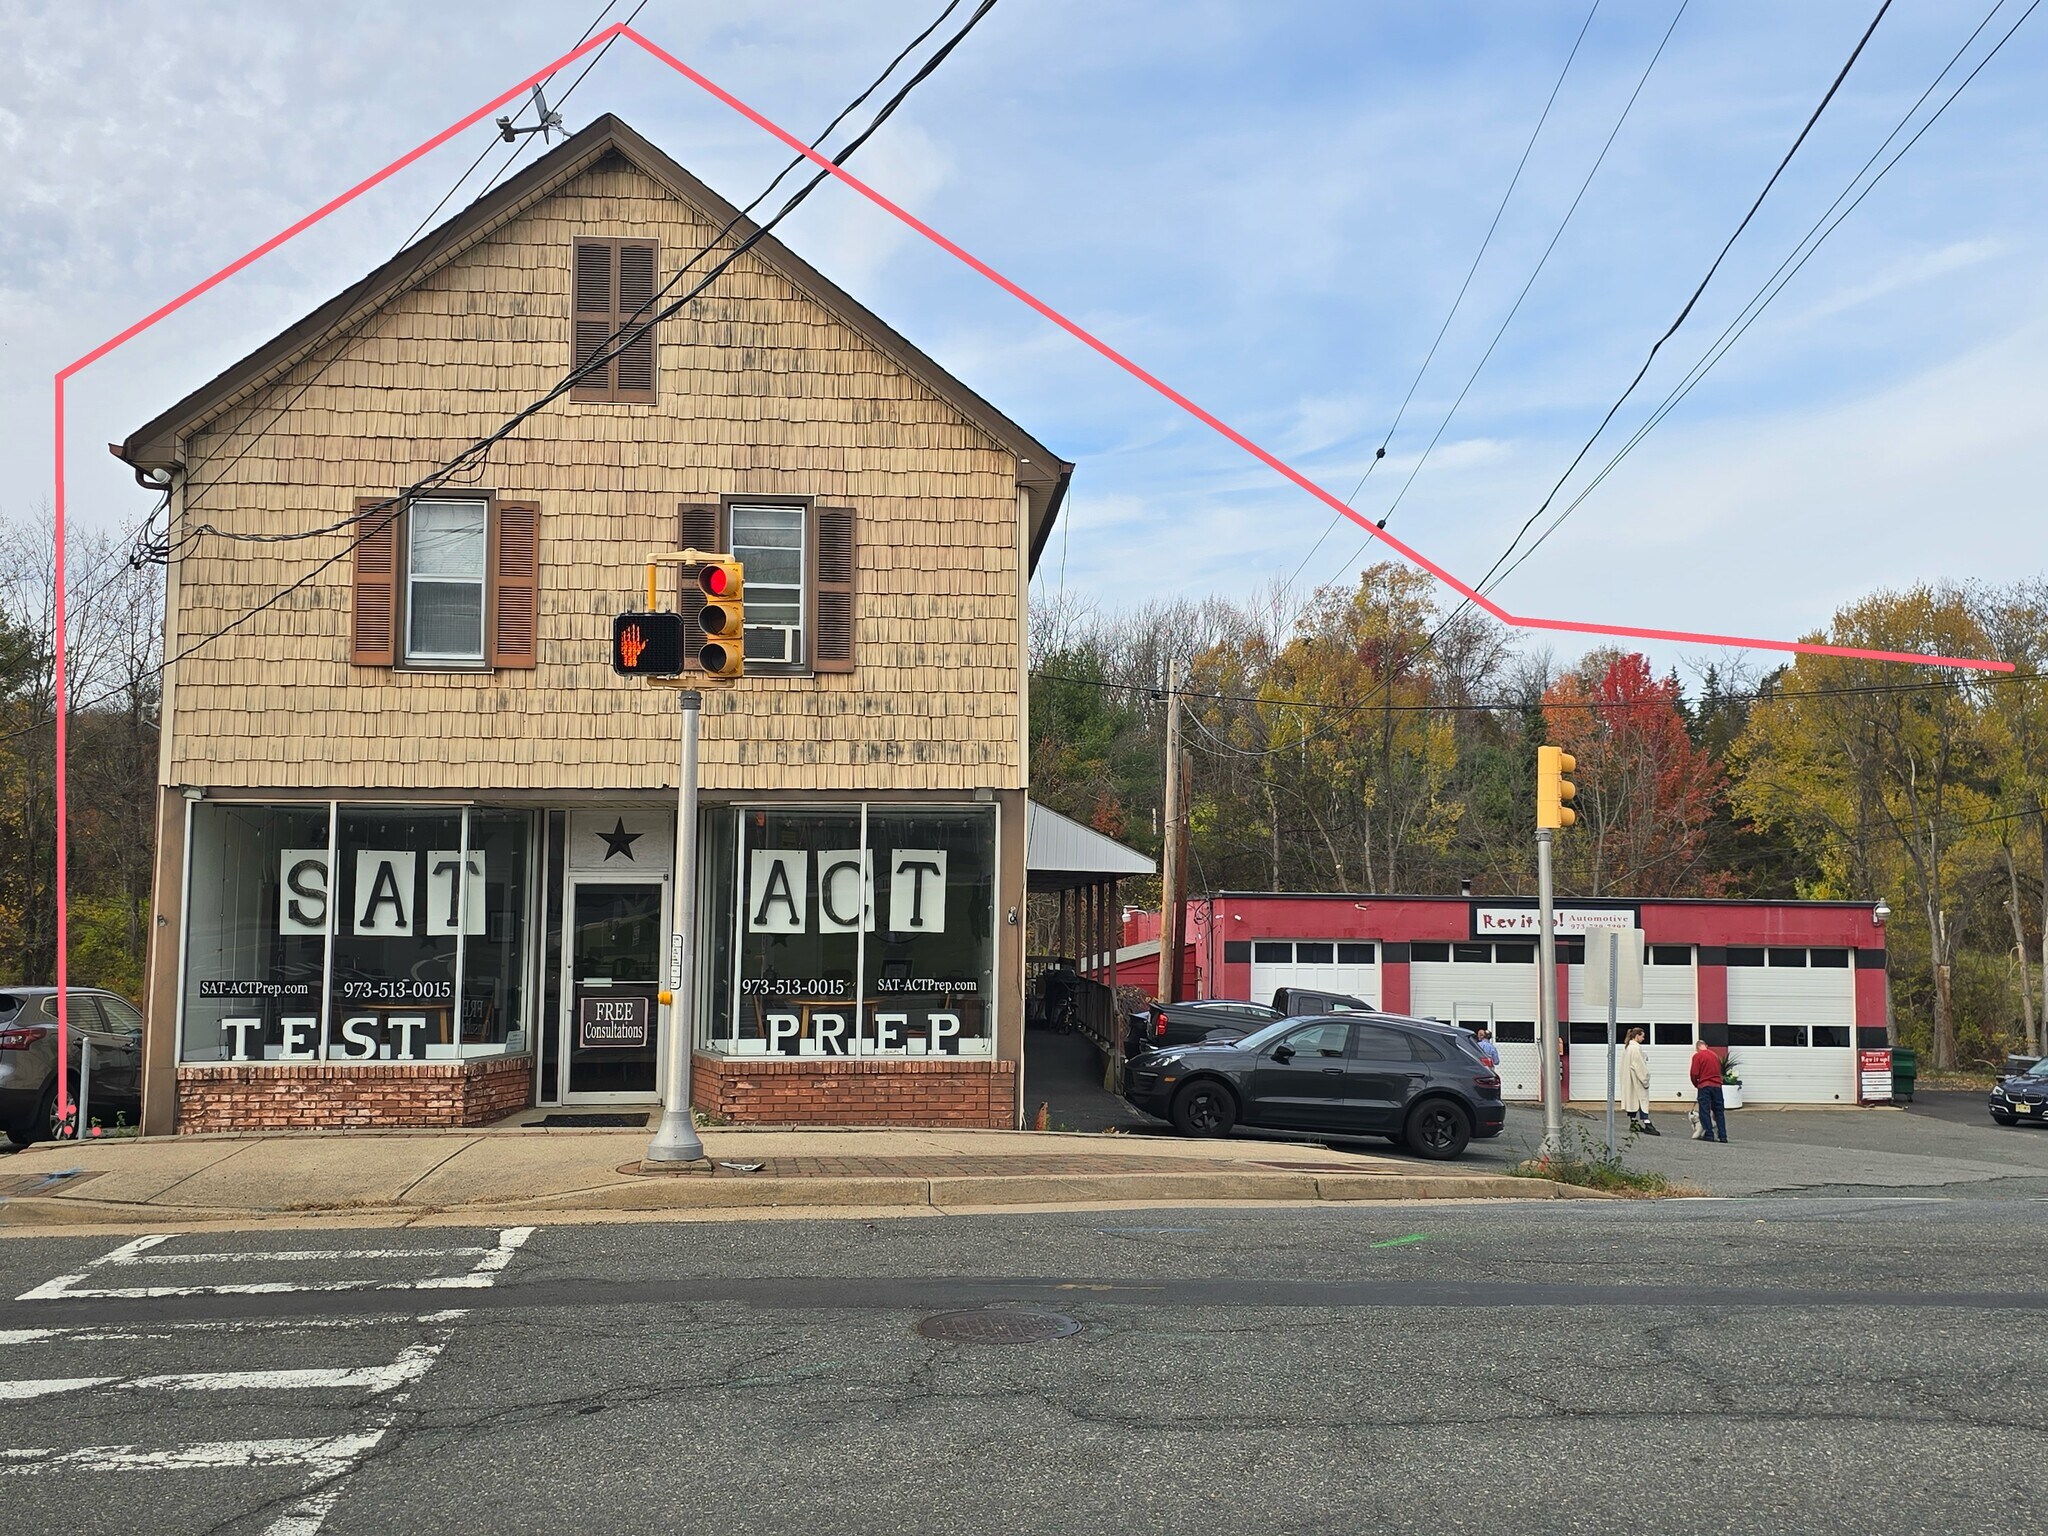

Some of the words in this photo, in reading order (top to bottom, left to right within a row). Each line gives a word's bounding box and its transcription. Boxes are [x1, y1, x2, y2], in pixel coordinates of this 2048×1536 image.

[287, 859, 480, 928] SAT
[754, 859, 941, 926] ACT
[1483, 913, 1516, 928] Rev
[1520, 914, 1533, 928] it
[1569, 914, 1628, 922] Automotive
[201, 981, 308, 997] SAT-ACTPrep.com
[344, 981, 451, 998] 973-513-0015
[742, 979, 844, 995] 973-513-0015
[877, 978, 977, 994] SAT-ACTPrep.com
[596, 1002, 633, 1021] FREE
[585, 1021, 643, 1039] Consultations
[766, 1013, 960, 1055] PREP
[221, 1017, 426, 1061] TEST
